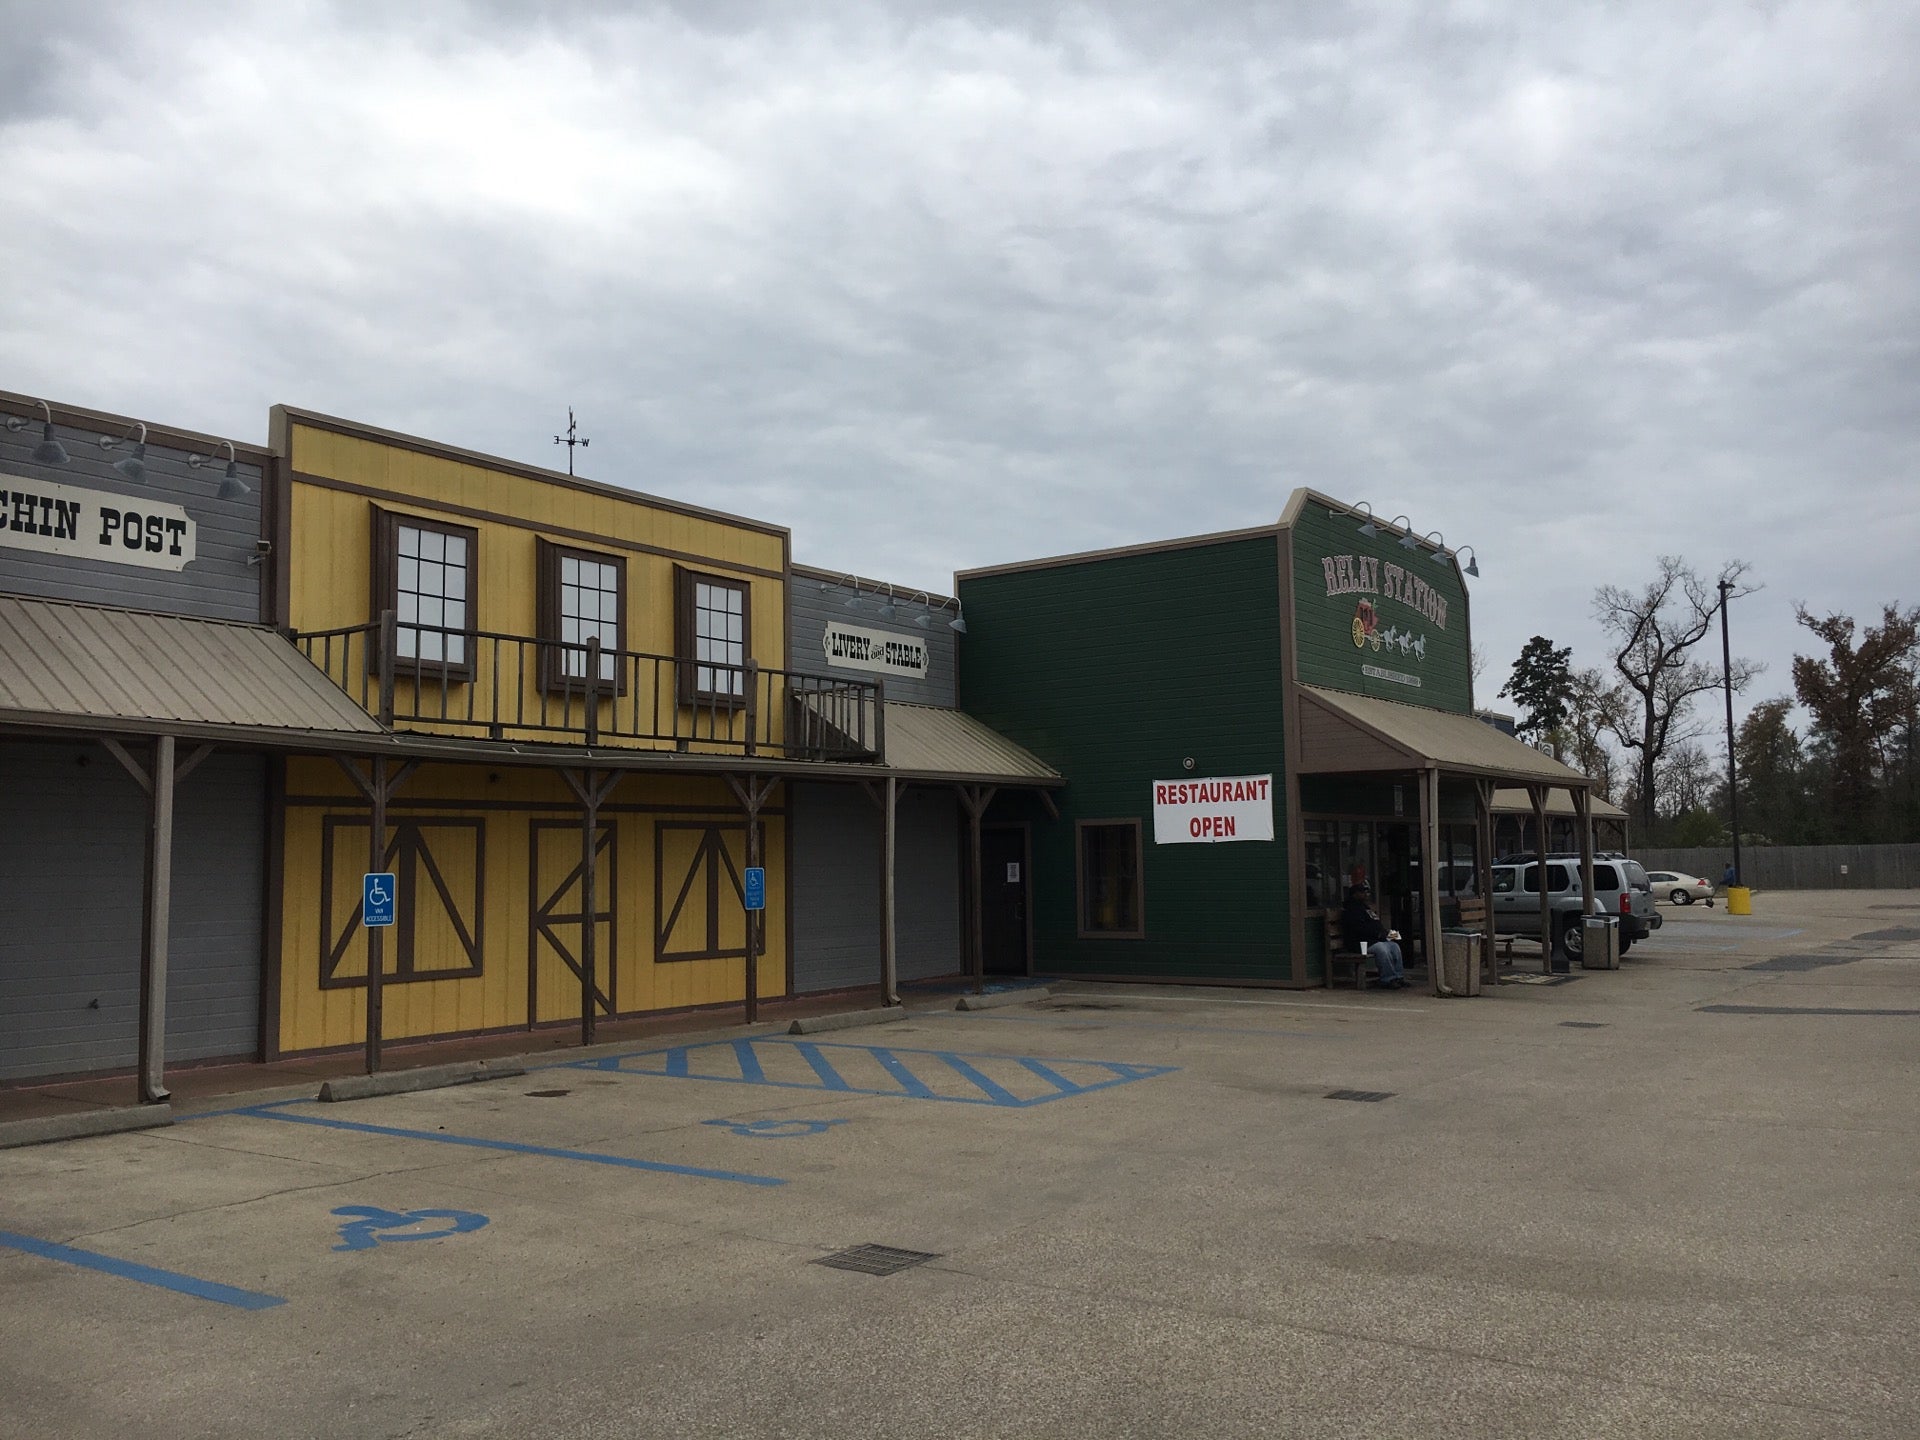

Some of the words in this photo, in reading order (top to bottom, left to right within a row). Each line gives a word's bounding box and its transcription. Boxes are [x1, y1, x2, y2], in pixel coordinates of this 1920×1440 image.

[99, 507, 186, 556] POST
[1322, 555, 1379, 596] RELAY
[1384, 561, 1448, 631] STATION
[832, 632, 871, 660] LIVERY
[885, 642, 921, 669] STABLE
[1157, 780, 1268, 805] RESTAURANT
[1190, 816, 1235, 837] OPEN
